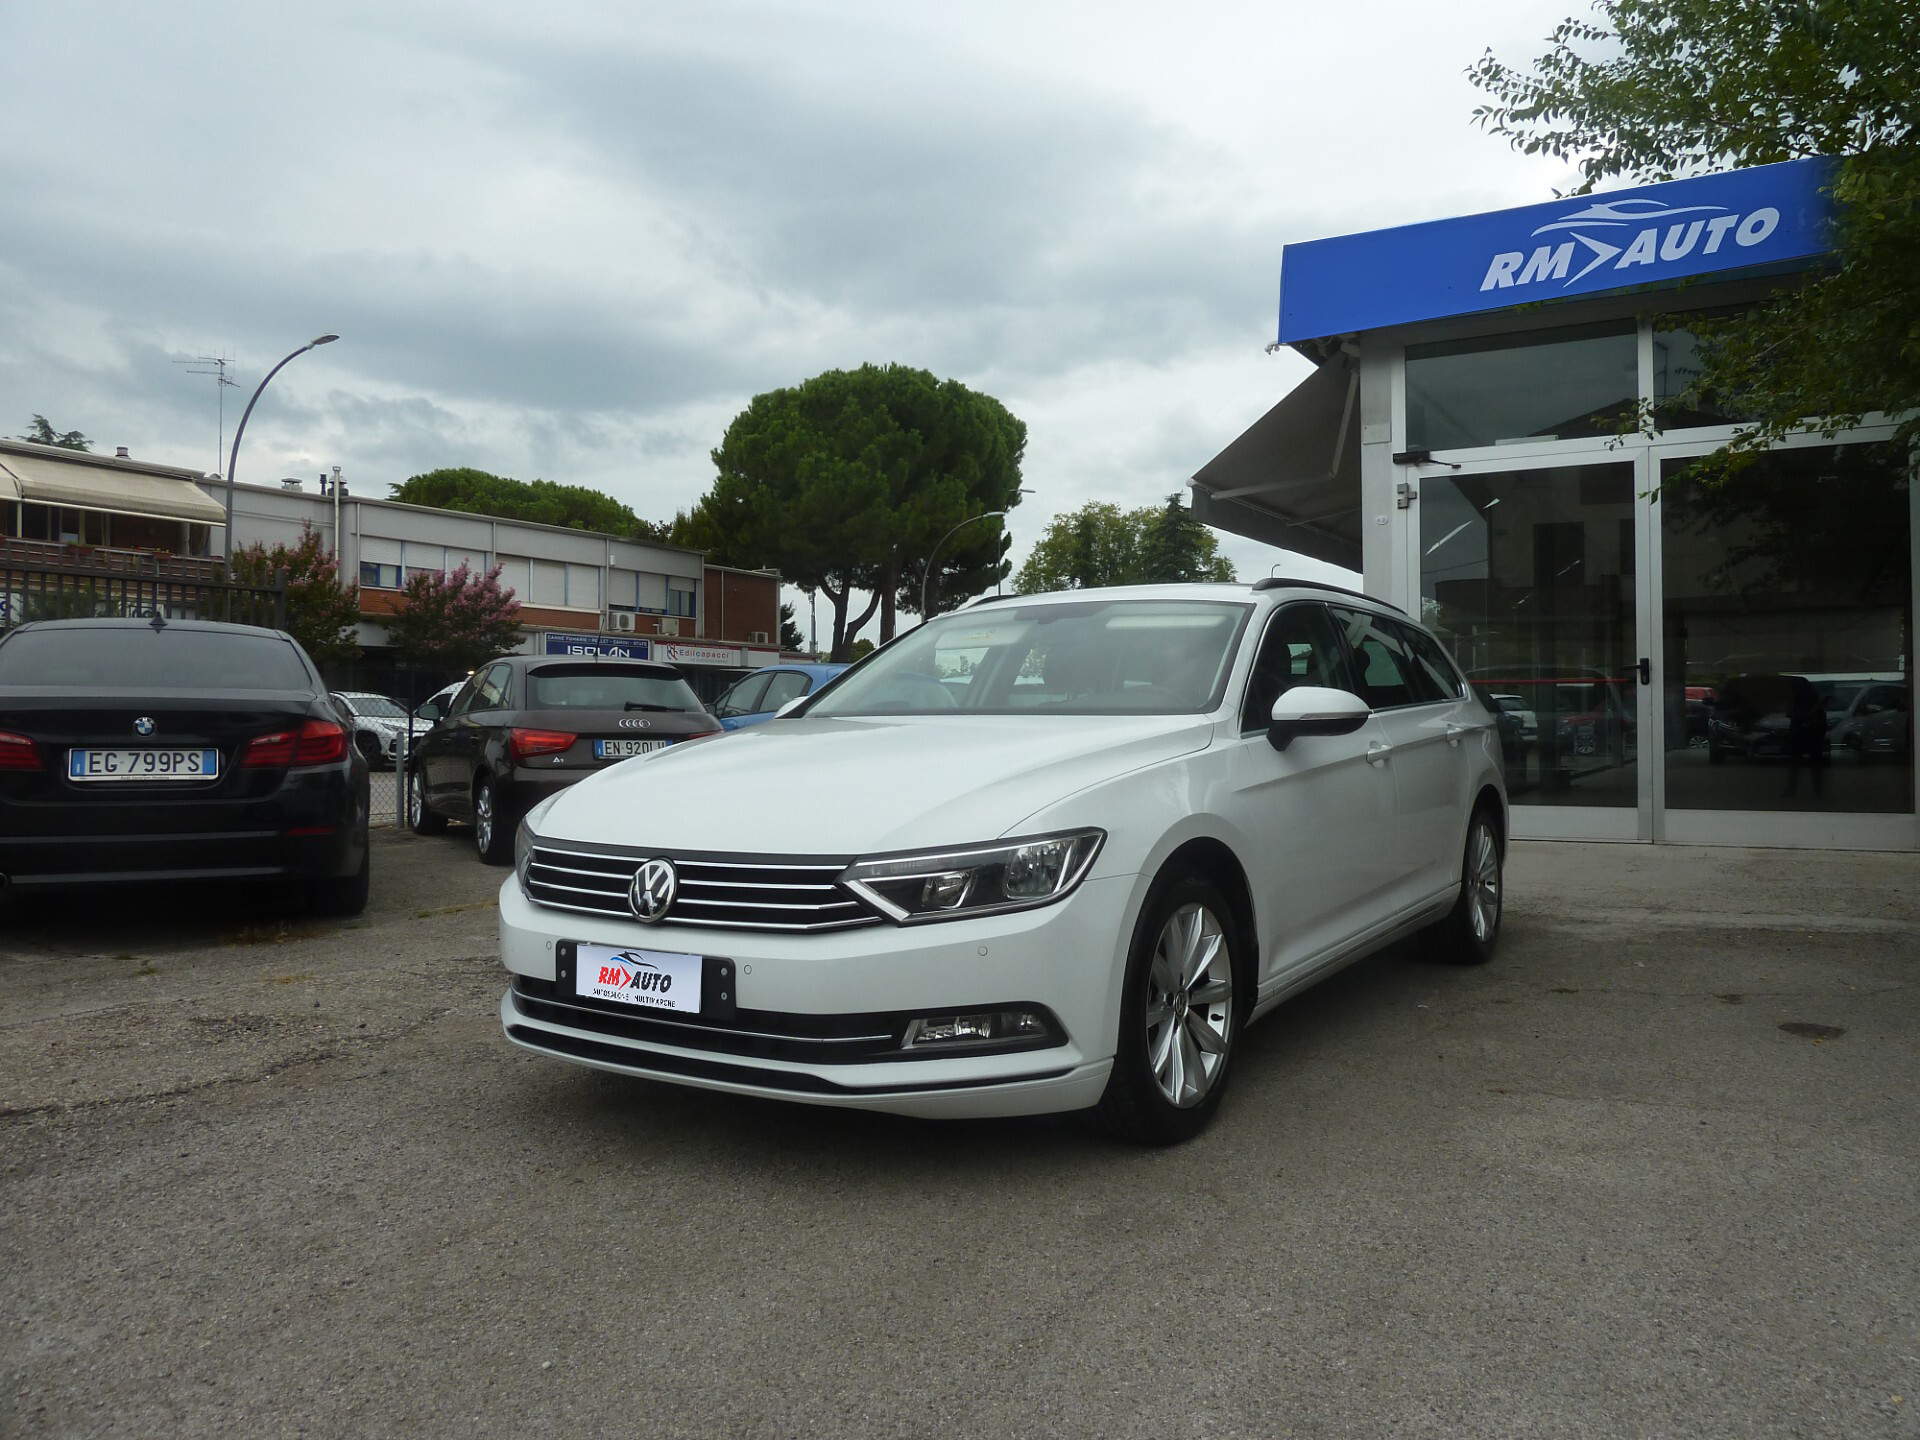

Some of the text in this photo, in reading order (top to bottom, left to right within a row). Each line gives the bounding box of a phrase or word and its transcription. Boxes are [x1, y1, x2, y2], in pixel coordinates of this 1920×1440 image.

[1479, 207, 1780, 291] RM AUTO
[567, 645, 630, 658] ISOLAN
[604, 741, 621, 755] EN
[88, 752, 118, 773] EG
[127, 752, 200, 773] 799PS
[597, 966, 672, 993] RM AUTO
